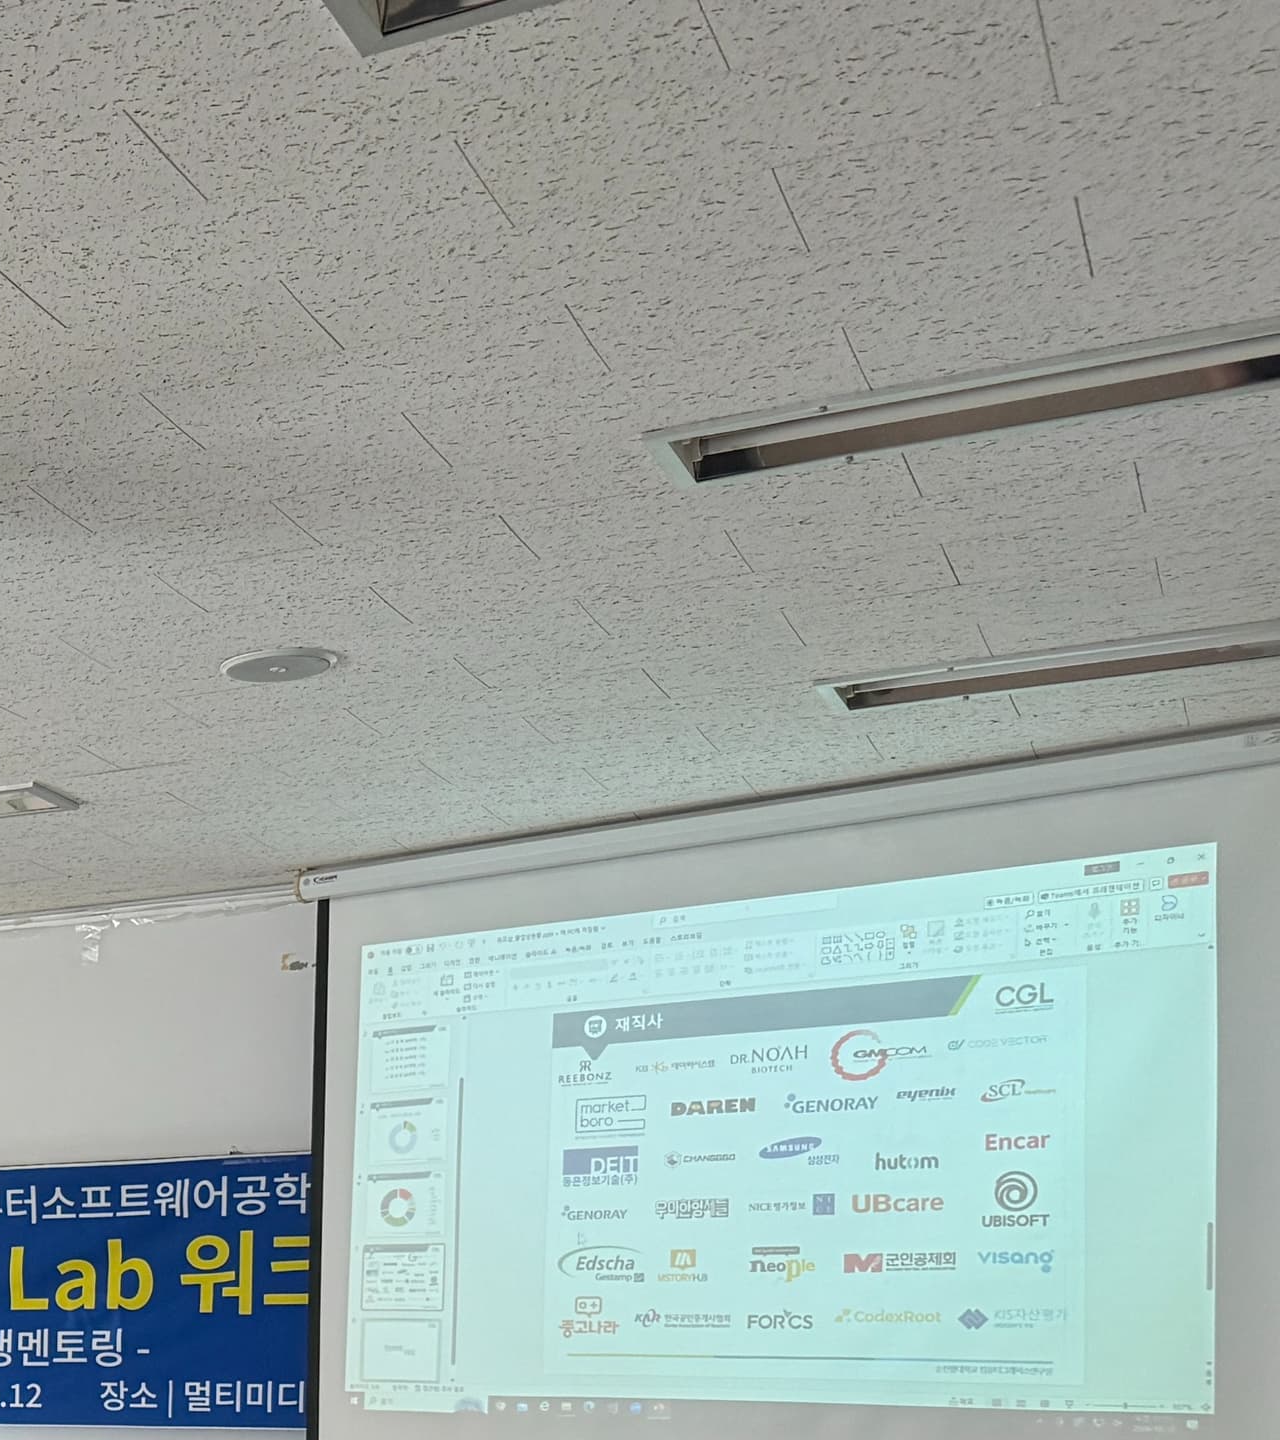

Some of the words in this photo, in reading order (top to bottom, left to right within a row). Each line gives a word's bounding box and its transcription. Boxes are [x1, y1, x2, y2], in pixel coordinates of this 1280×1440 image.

[995, 982, 1054, 1008] CGL
[615, 1012, 664, 1032] 재직사
[558, 1071, 612, 1084] REEBONZ
[988, 1082, 1022, 1097] SCL
[581, 1099, 630, 1114] market
[670, 1097, 756, 1117] DAREN
[792, 1095, 878, 1114] GENORAY
[580, 1114, 613, 1128] boro
[765, 1142, 816, 1153] SAMSUNG
[984, 1133, 1051, 1151] Encar
[590, 1155, 638, 1174] DEIT
[851, 1193, 944, 1213] UBcare
[567, 1209, 628, 1221] GENORAY
[981, 1214, 1050, 1228] UBISOFT
[575, 1256, 635, 1271] Edscha
[885, 1251, 956, 1267] 군인공제회
[9, 1238, 155, 1312] Lab
[595, 1272, 633, 1283] Gestamp
[854, 1308, 942, 1323] CodexRoot
[559, 1319, 620, 1338] 중고나라
[99, 1379, 158, 1412] 장소
[183, 1379, 306, 1414] 멀티미디
